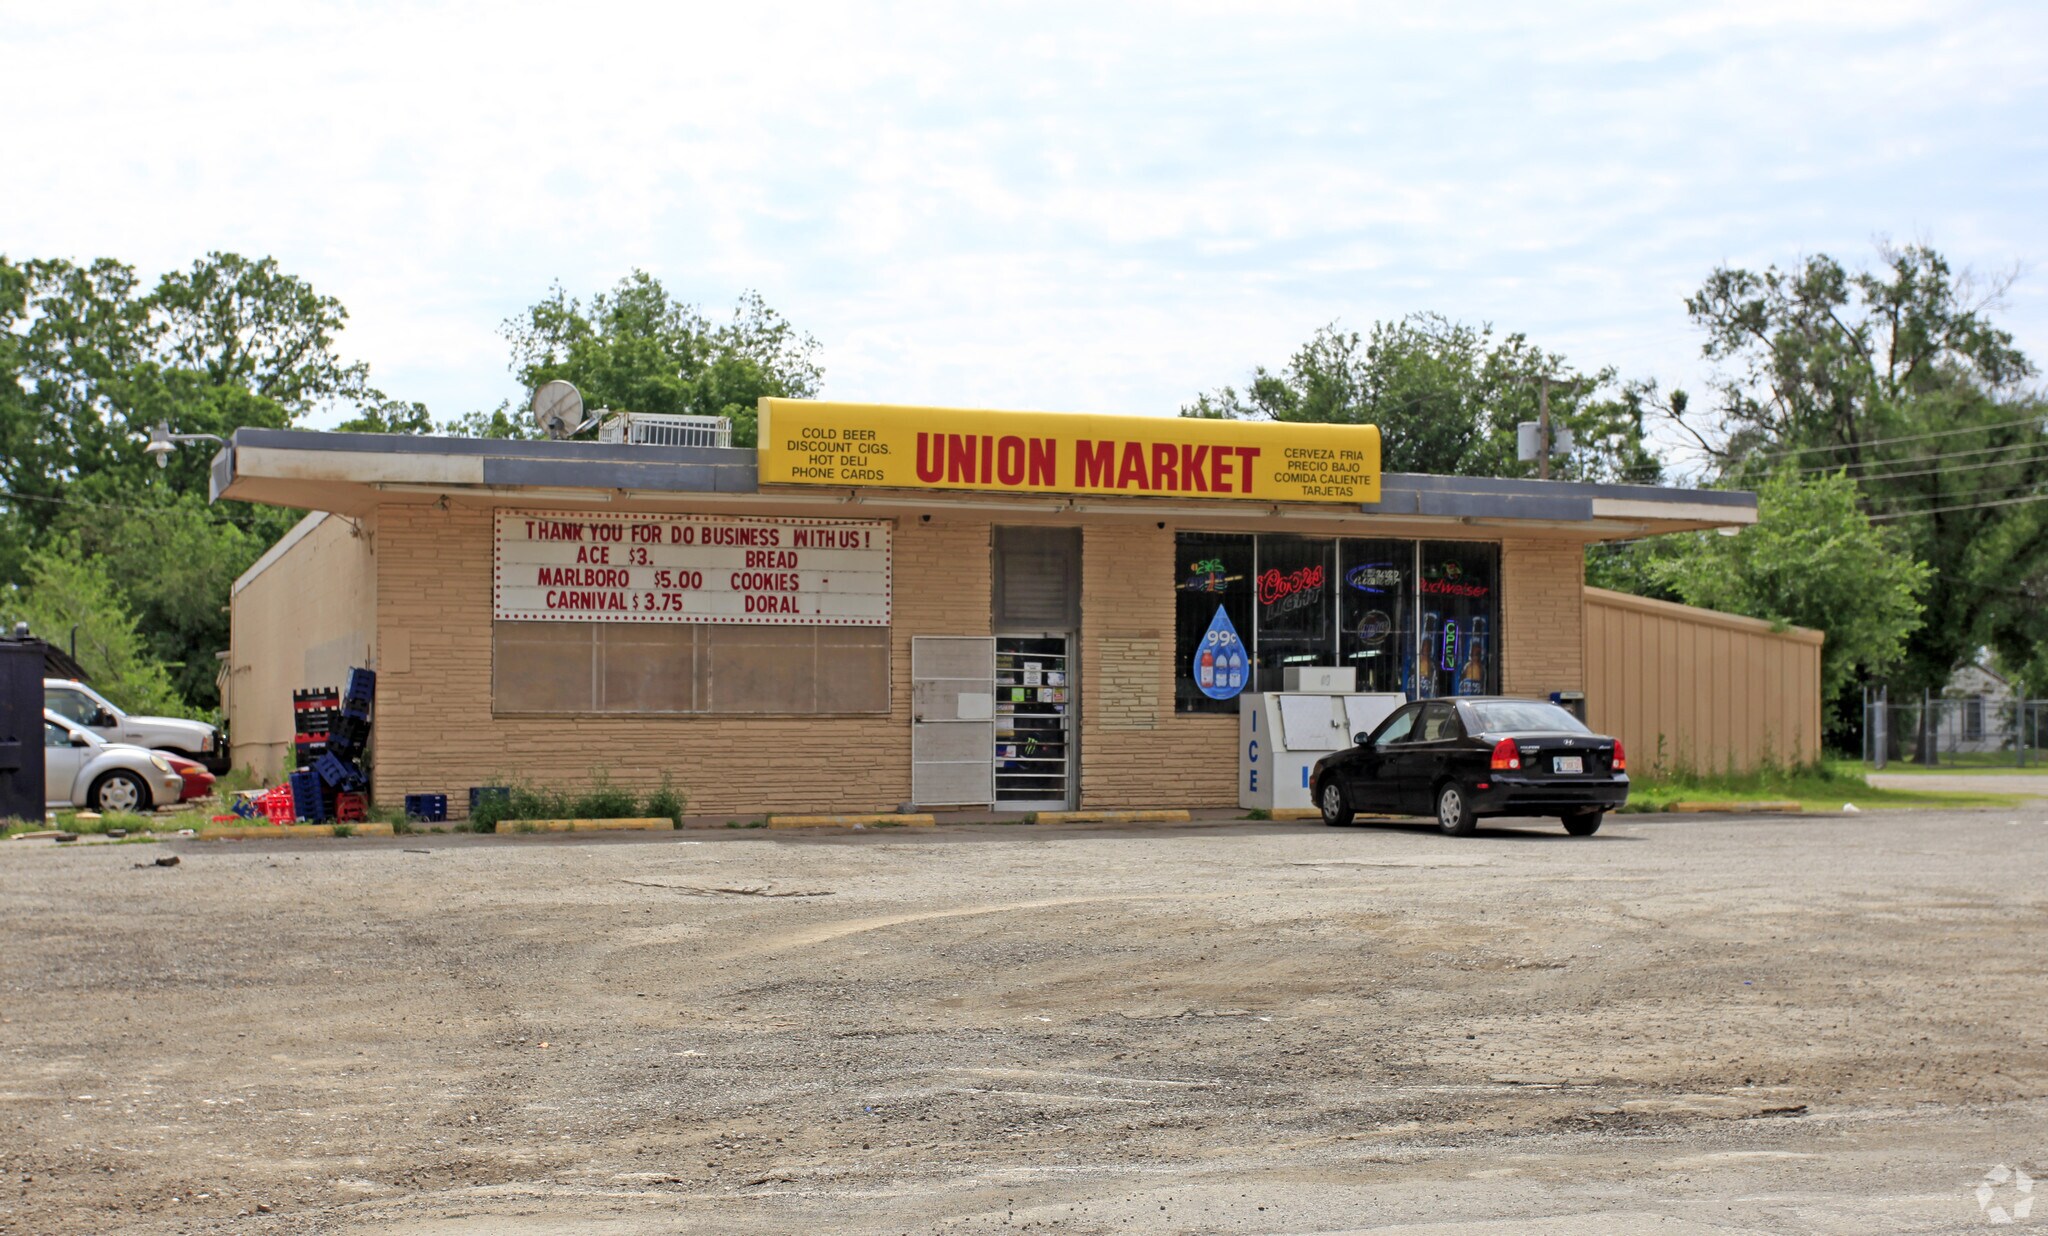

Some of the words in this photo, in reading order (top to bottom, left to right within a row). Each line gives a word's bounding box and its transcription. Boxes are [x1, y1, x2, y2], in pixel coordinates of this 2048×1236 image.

[801, 427, 837, 440] COLD
[843, 429, 876, 441] BEER
[787, 440, 853, 453] DISCOUNT
[858, 443, 892, 455] CIGS.
[1284, 447, 1335, 460] CERVEZA
[1340, 450, 1364, 461] FRIA
[809, 454, 834, 466] HOT
[840, 455, 868, 467] DELI
[916, 432, 1057, 487] UNION
[1074, 439, 1261, 493] MARKET
[1287, 460, 1329, 472] PRECIO
[1332, 462, 1360, 473] BAJO
[791, 467, 834, 479] PHONE
[841, 469, 884, 481] CARDS
[1274, 472, 1317, 484] COMIDA
[1319, 473, 1371, 485] CALIENTE
[1302, 484, 1354, 497] TARJETAS
[525, 520, 584, 541] THANK
[590, 523, 623, 542] YOU
[631, 524, 662, 543] FOR
[671, 525, 695, 545] DO
[701, 527, 780, 547] BUSINESS
[793, 529, 835, 548] WITH
[576, 545, 609, 565] ACE
[628, 547, 654, 566] $3.
[745, 550, 799, 569] BREAD
[537, 567, 630, 588] MARLBORO
[653, 570, 703, 590] $5.00
[730, 572, 800, 592] COOKIES
[546, 590, 628, 611] CARNIVAL
[744, 594, 800, 614] DORAL
[1248, 710, 1258, 792] ICE
